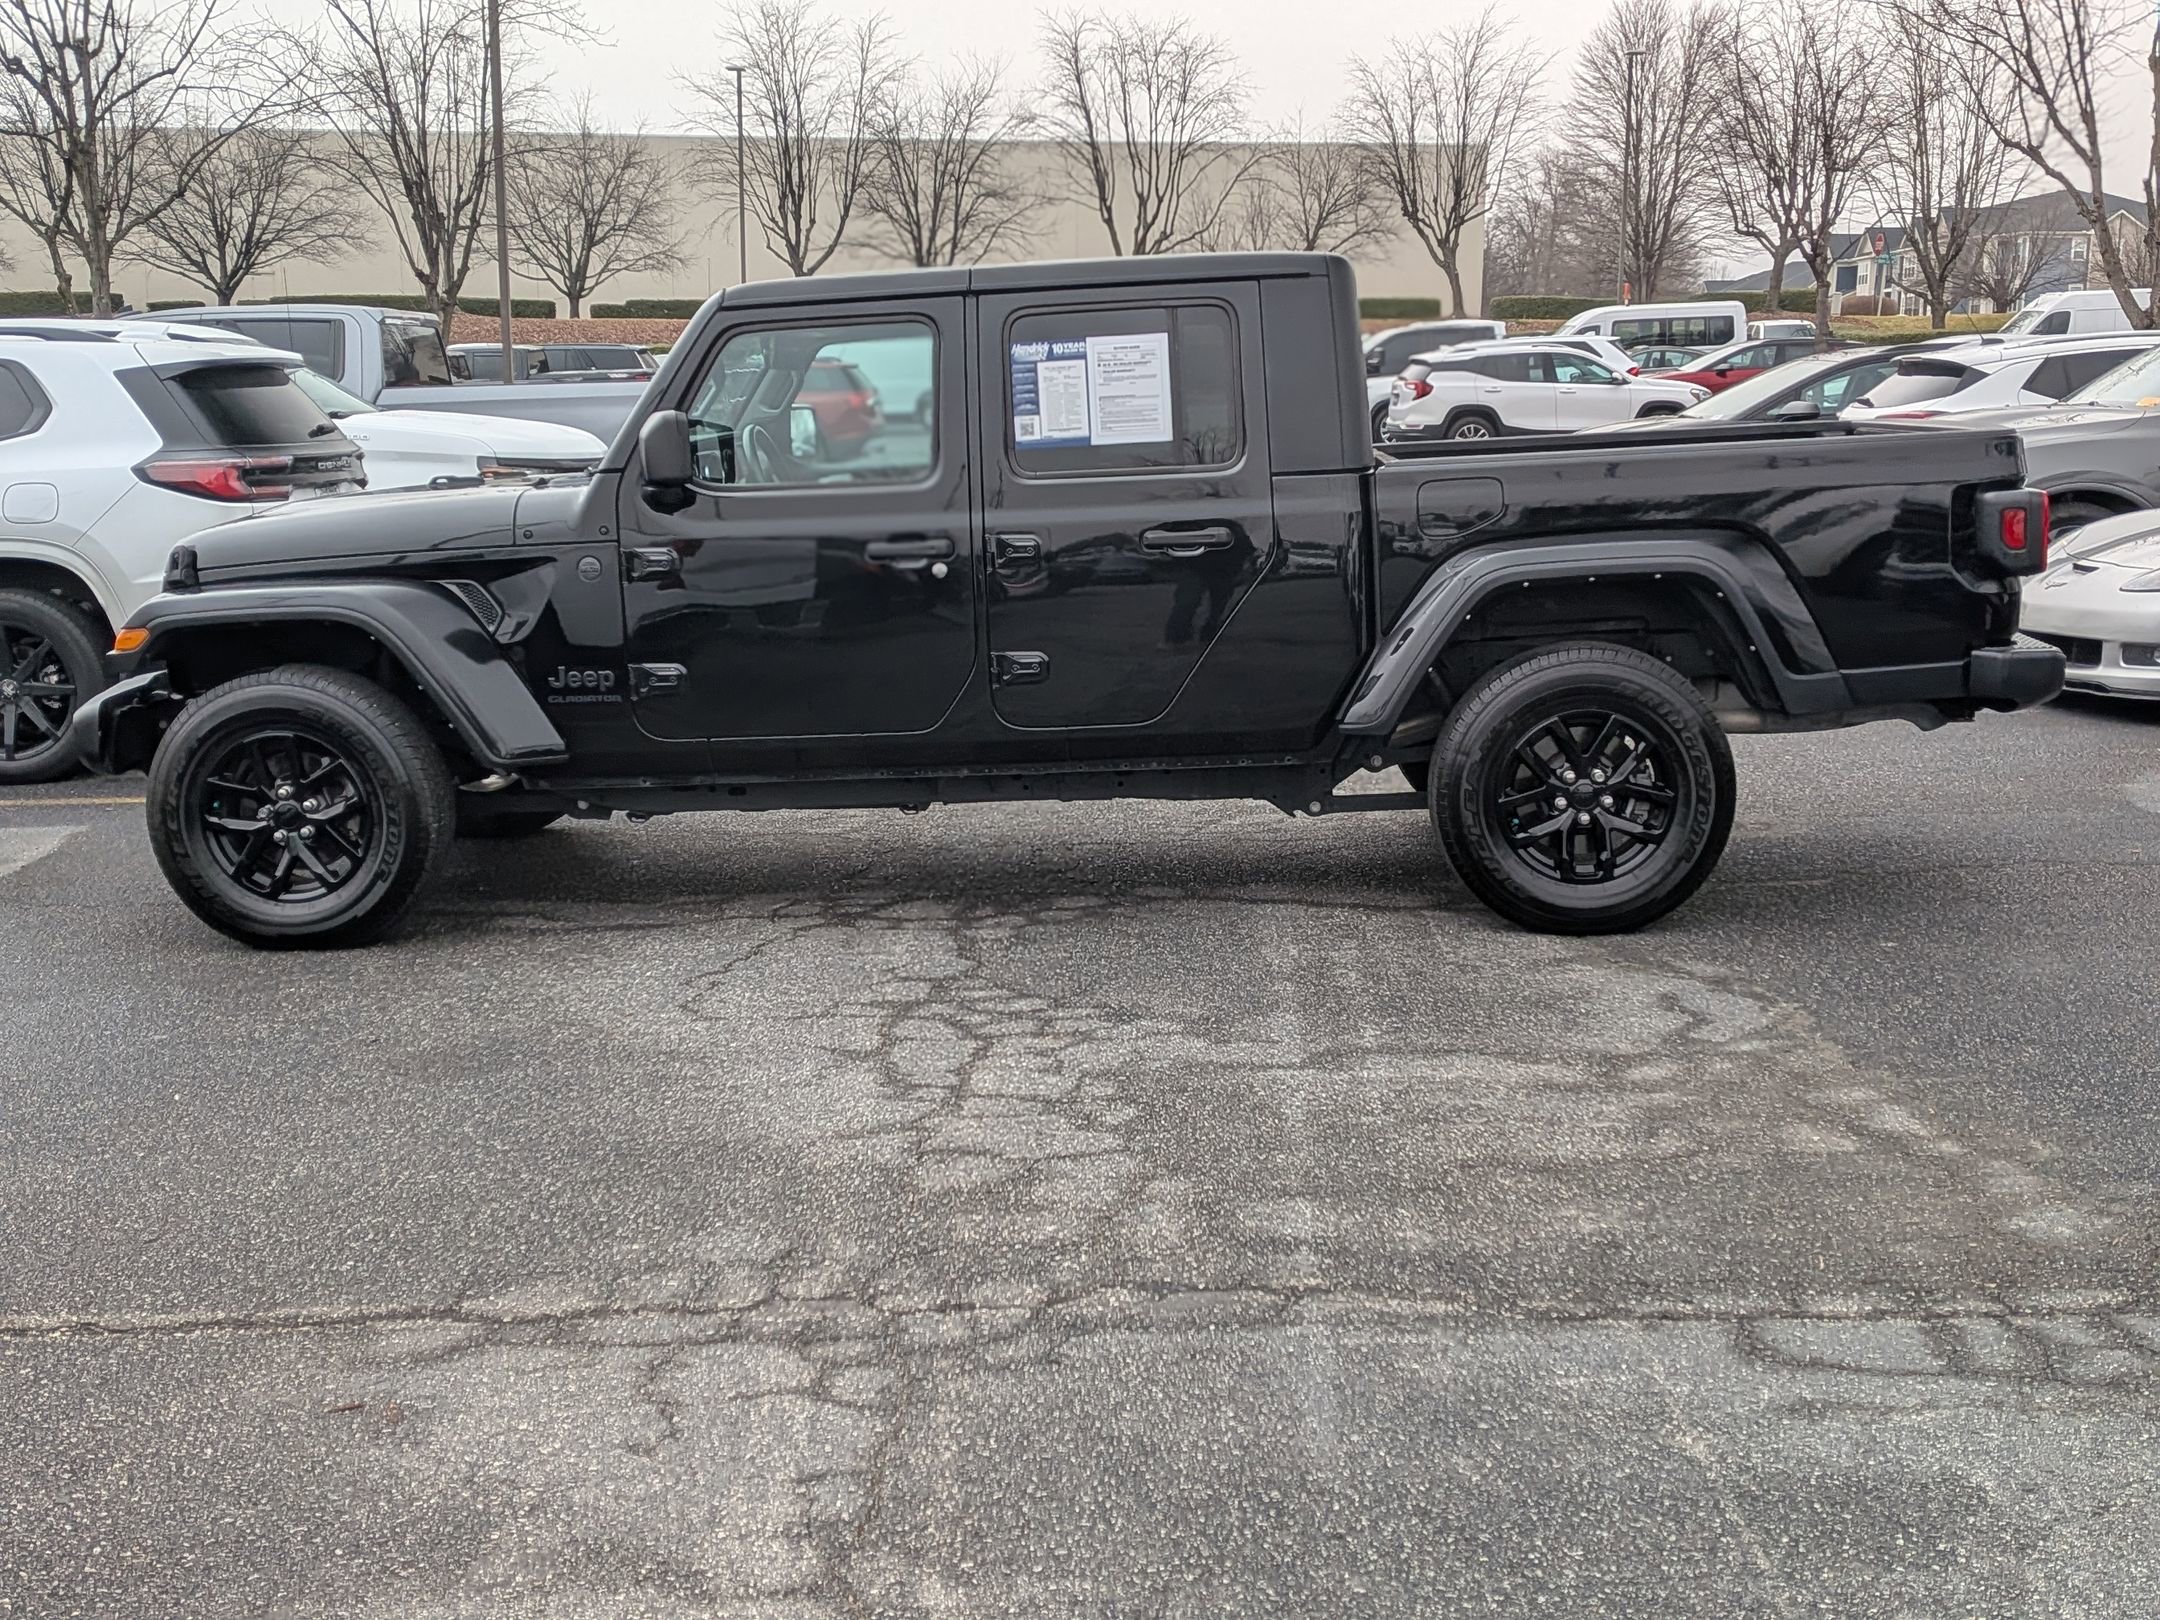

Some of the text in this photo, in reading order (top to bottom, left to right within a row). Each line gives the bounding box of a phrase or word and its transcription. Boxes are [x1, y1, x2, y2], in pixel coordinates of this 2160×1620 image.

[1052, 342, 1063, 354] 10
[548, 665, 615, 691] Jeep
[547, 694, 622, 703] GLADIATOR
